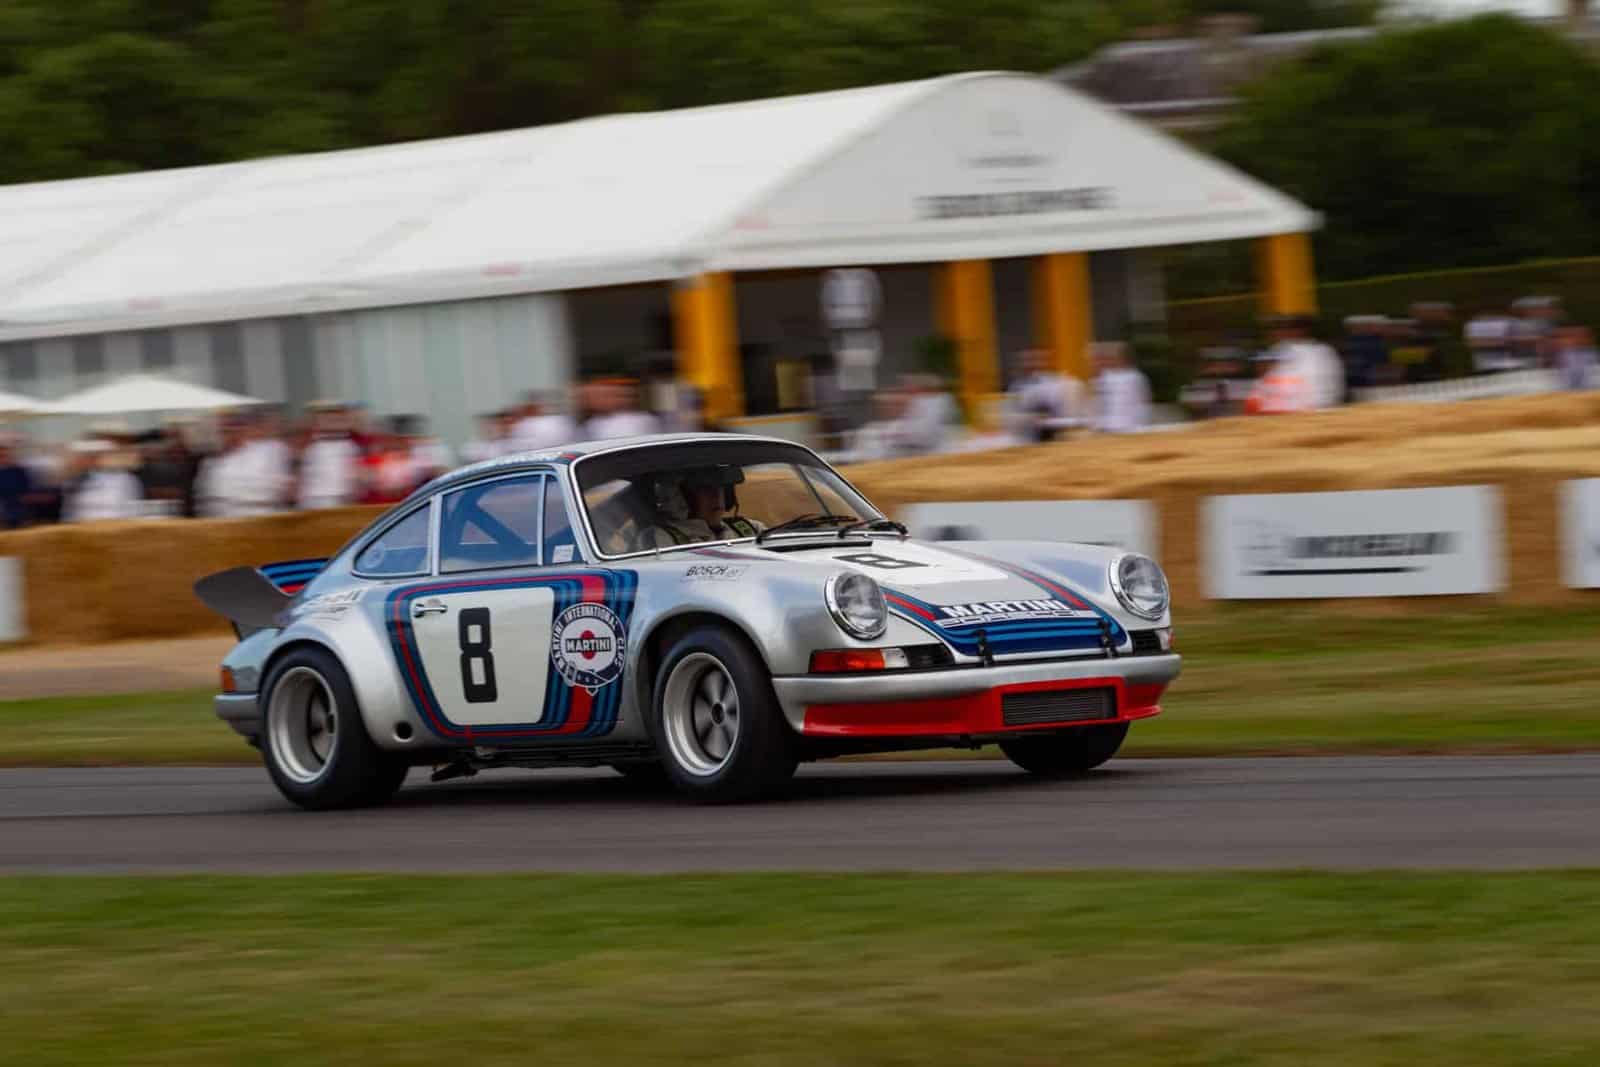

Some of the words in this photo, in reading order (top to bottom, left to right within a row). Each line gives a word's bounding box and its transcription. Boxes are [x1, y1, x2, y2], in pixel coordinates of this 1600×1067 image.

[832, 553, 928, 569] 8
[686, 565, 728, 577] BOSCH
[941, 599, 1072, 618] MARTINI
[567, 639, 610, 652] MARTINI
[458, 607, 498, 704] 8
